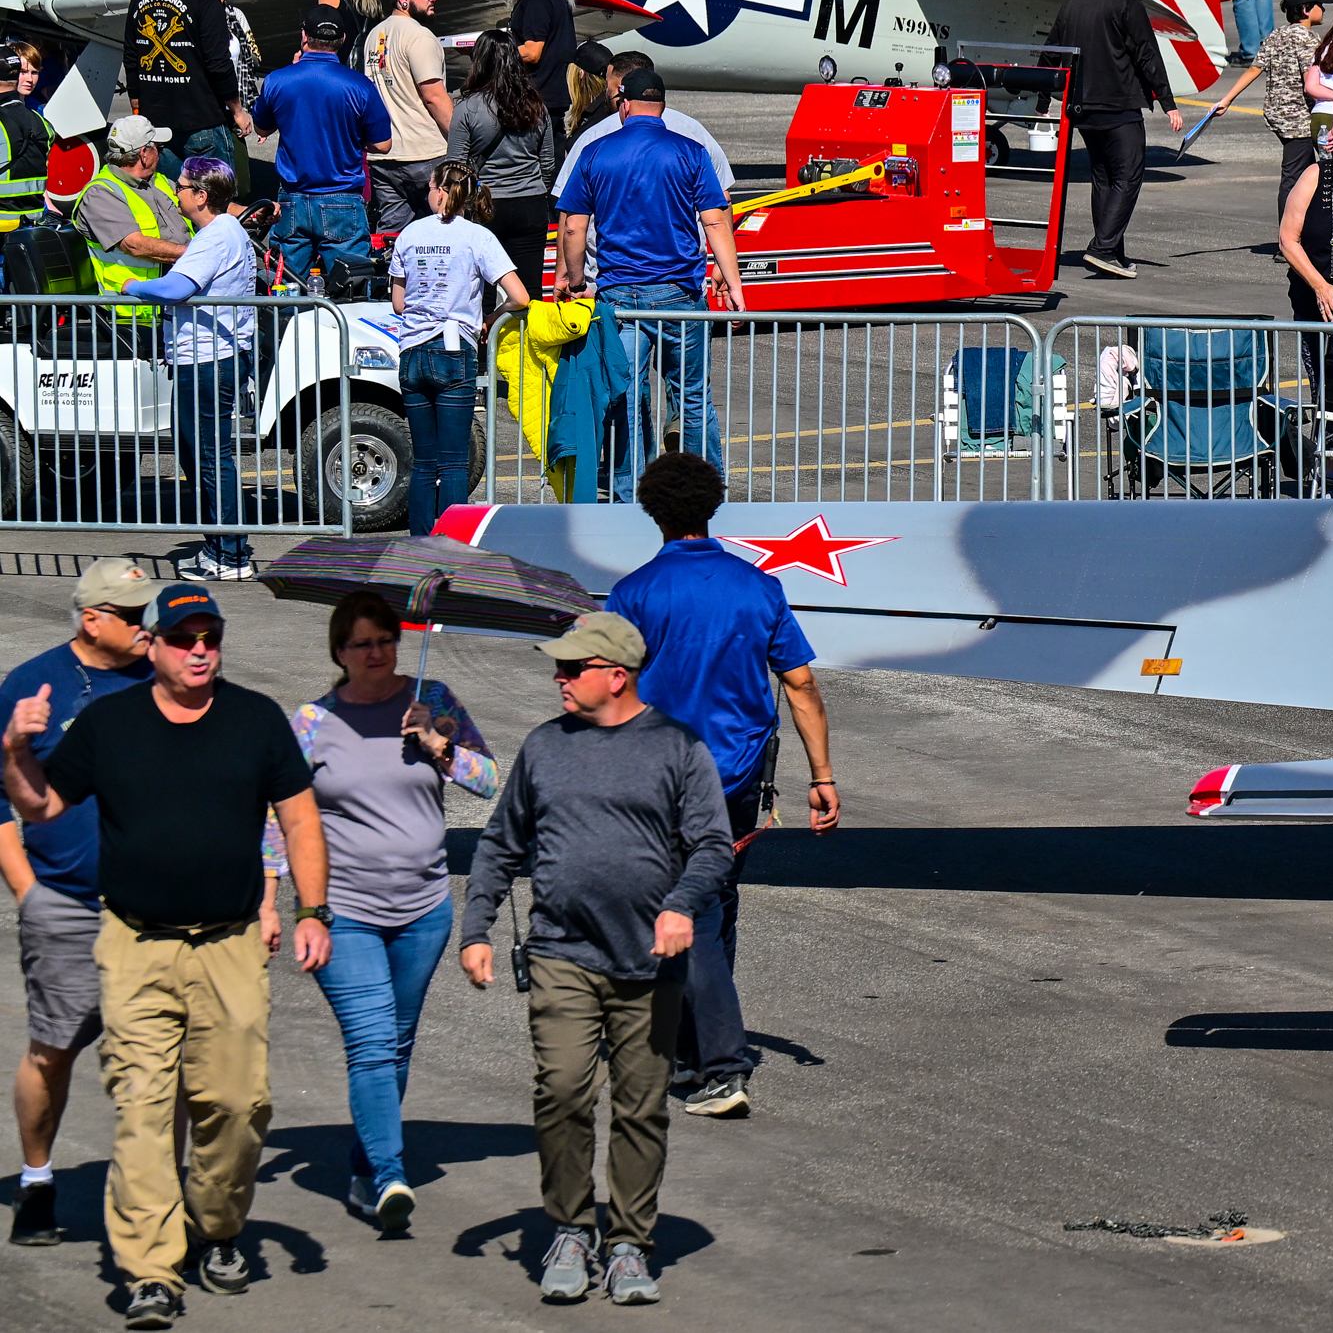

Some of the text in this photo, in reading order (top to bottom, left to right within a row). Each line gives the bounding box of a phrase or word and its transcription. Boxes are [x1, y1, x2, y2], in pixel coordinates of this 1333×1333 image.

[892, 16, 950, 40] N99NS
[139, 74, 162, 82] CLEAN
[415, 246, 451, 254] VOLUNTEER
